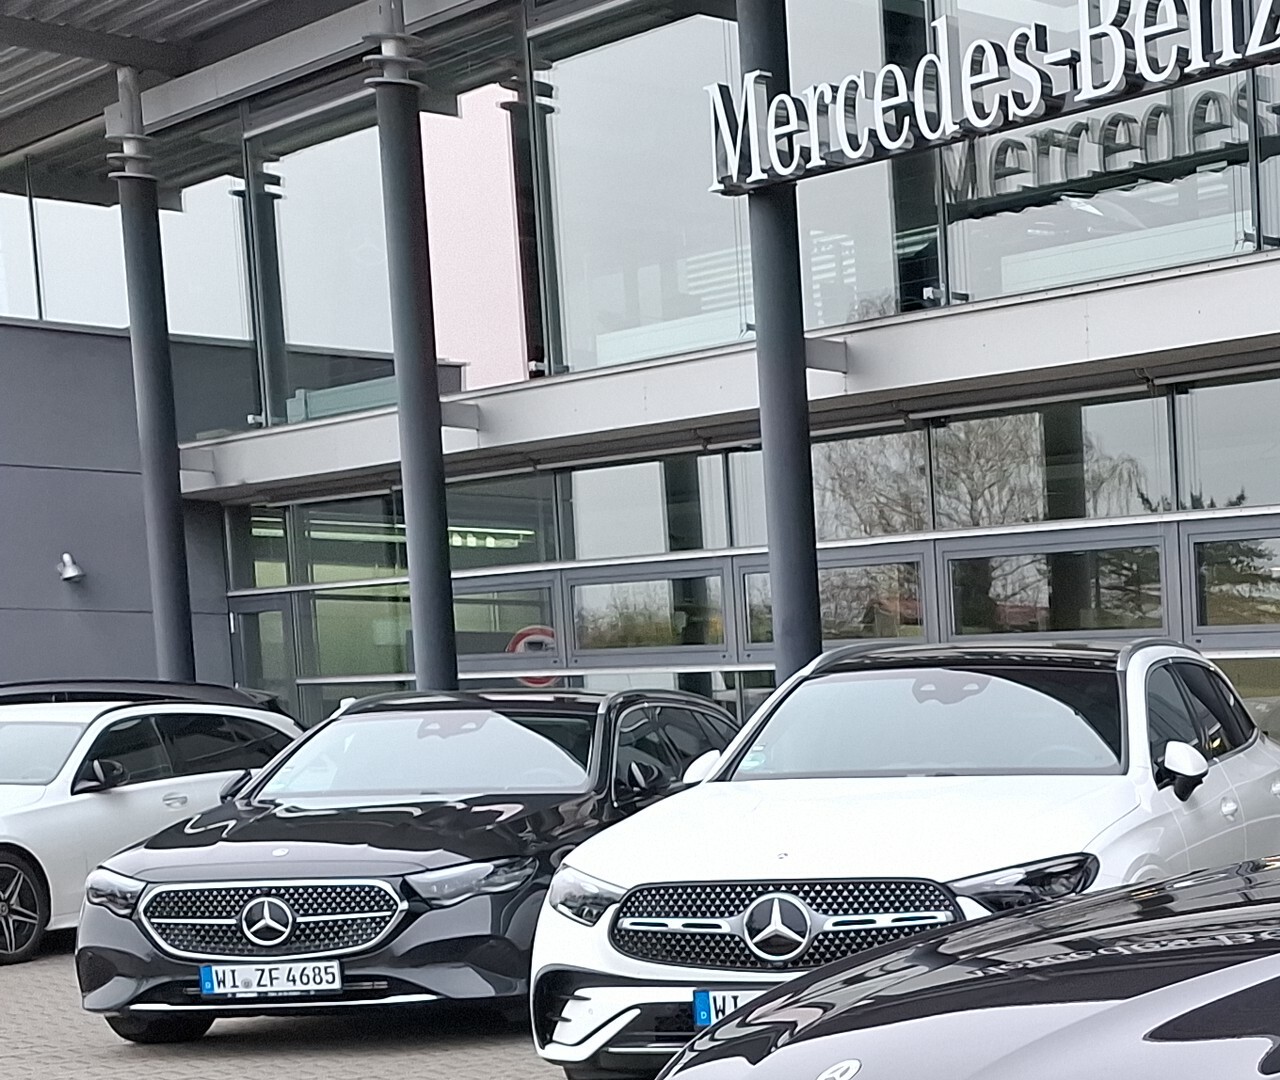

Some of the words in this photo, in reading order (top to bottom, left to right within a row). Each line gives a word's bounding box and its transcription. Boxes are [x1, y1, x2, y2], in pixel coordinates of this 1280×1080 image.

[215, 969, 240, 989] WI
[254, 967, 281, 988] ZF
[286, 965, 337, 987] 4685
